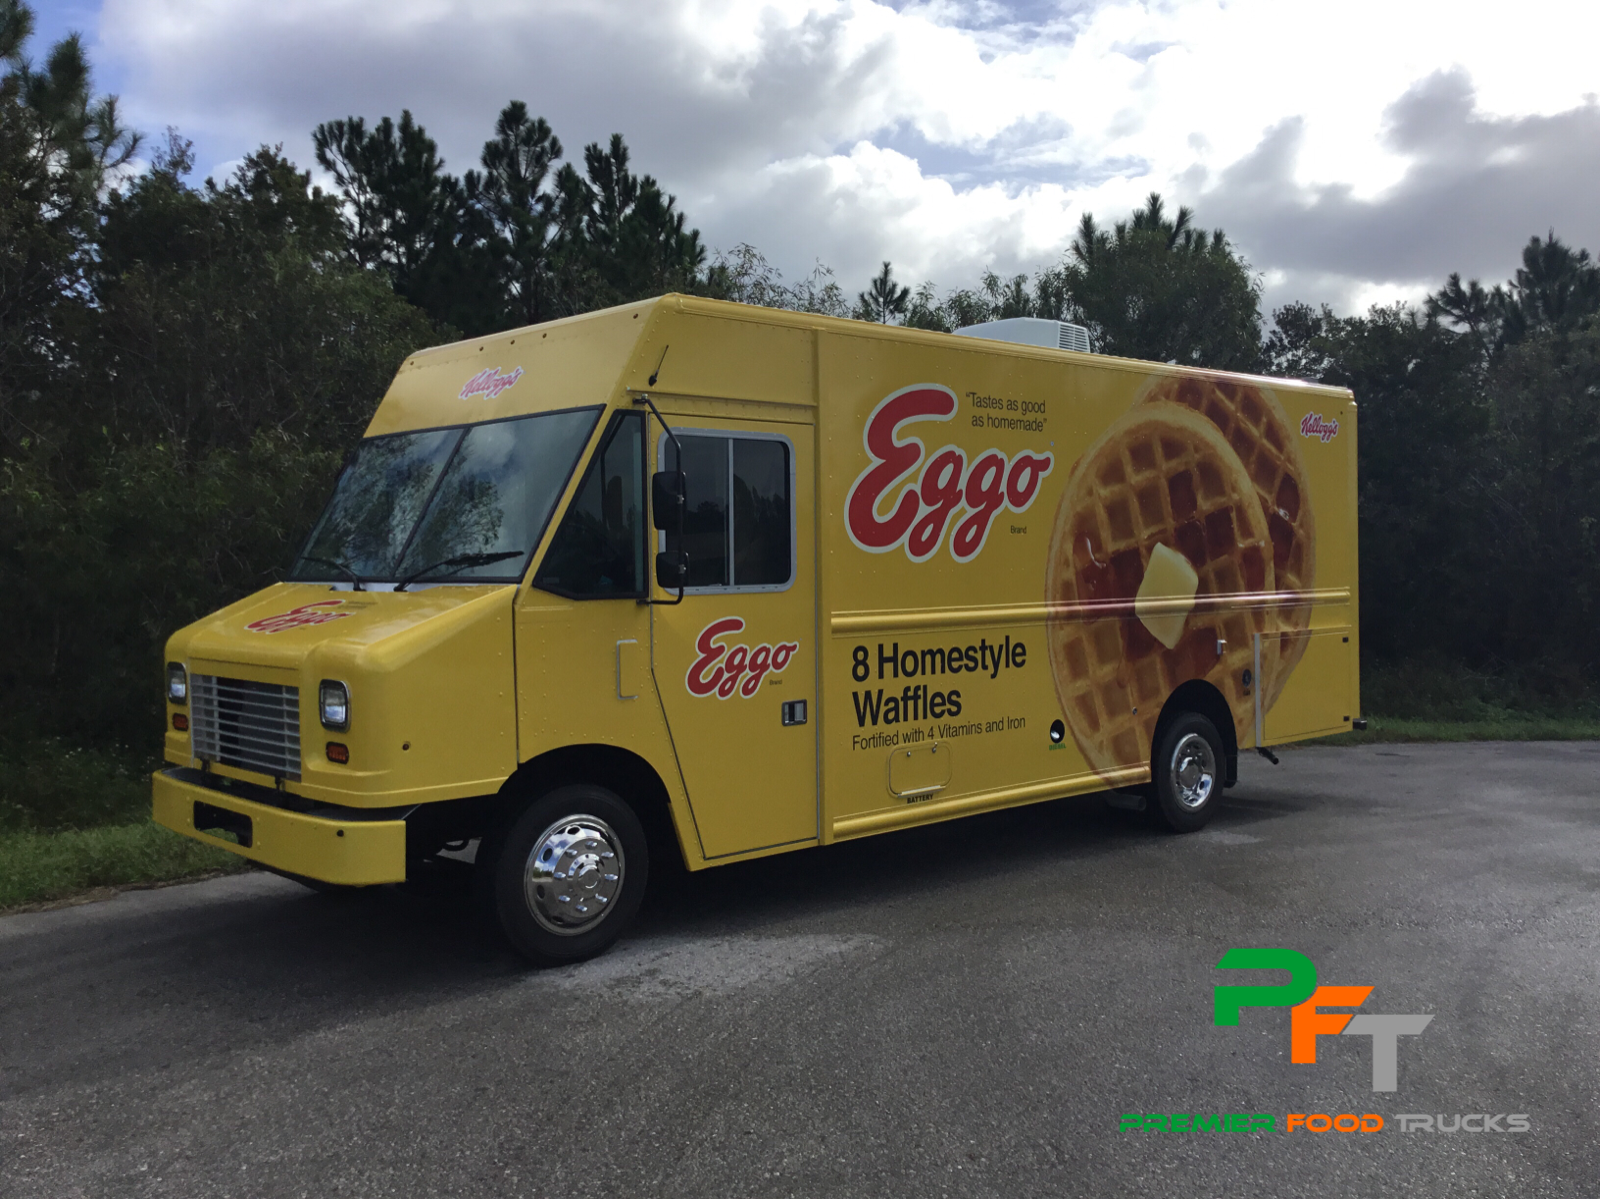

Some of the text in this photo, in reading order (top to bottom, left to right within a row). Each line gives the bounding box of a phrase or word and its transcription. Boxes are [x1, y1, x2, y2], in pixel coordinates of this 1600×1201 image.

[458, 365, 523, 400] Kellogg's
[971, 414, 985, 428] as
[1006, 399, 1019, 412] as
[1021, 399, 1046, 416] good
[1300, 411, 1338, 443] Kellogg's
[844, 383, 1054, 563] Eggo
[1010, 525, 1027, 534] Brand
[244, 599, 356, 634] Eggo
[685, 616, 799, 700] Eggo
[851, 635, 1027, 682] 8 Homestyle
[852, 684, 962, 727] Waffles
[852, 715, 1026, 751] Fortified with 4 Vitamins and Iron
[907, 794, 933, 804] BATTERY
